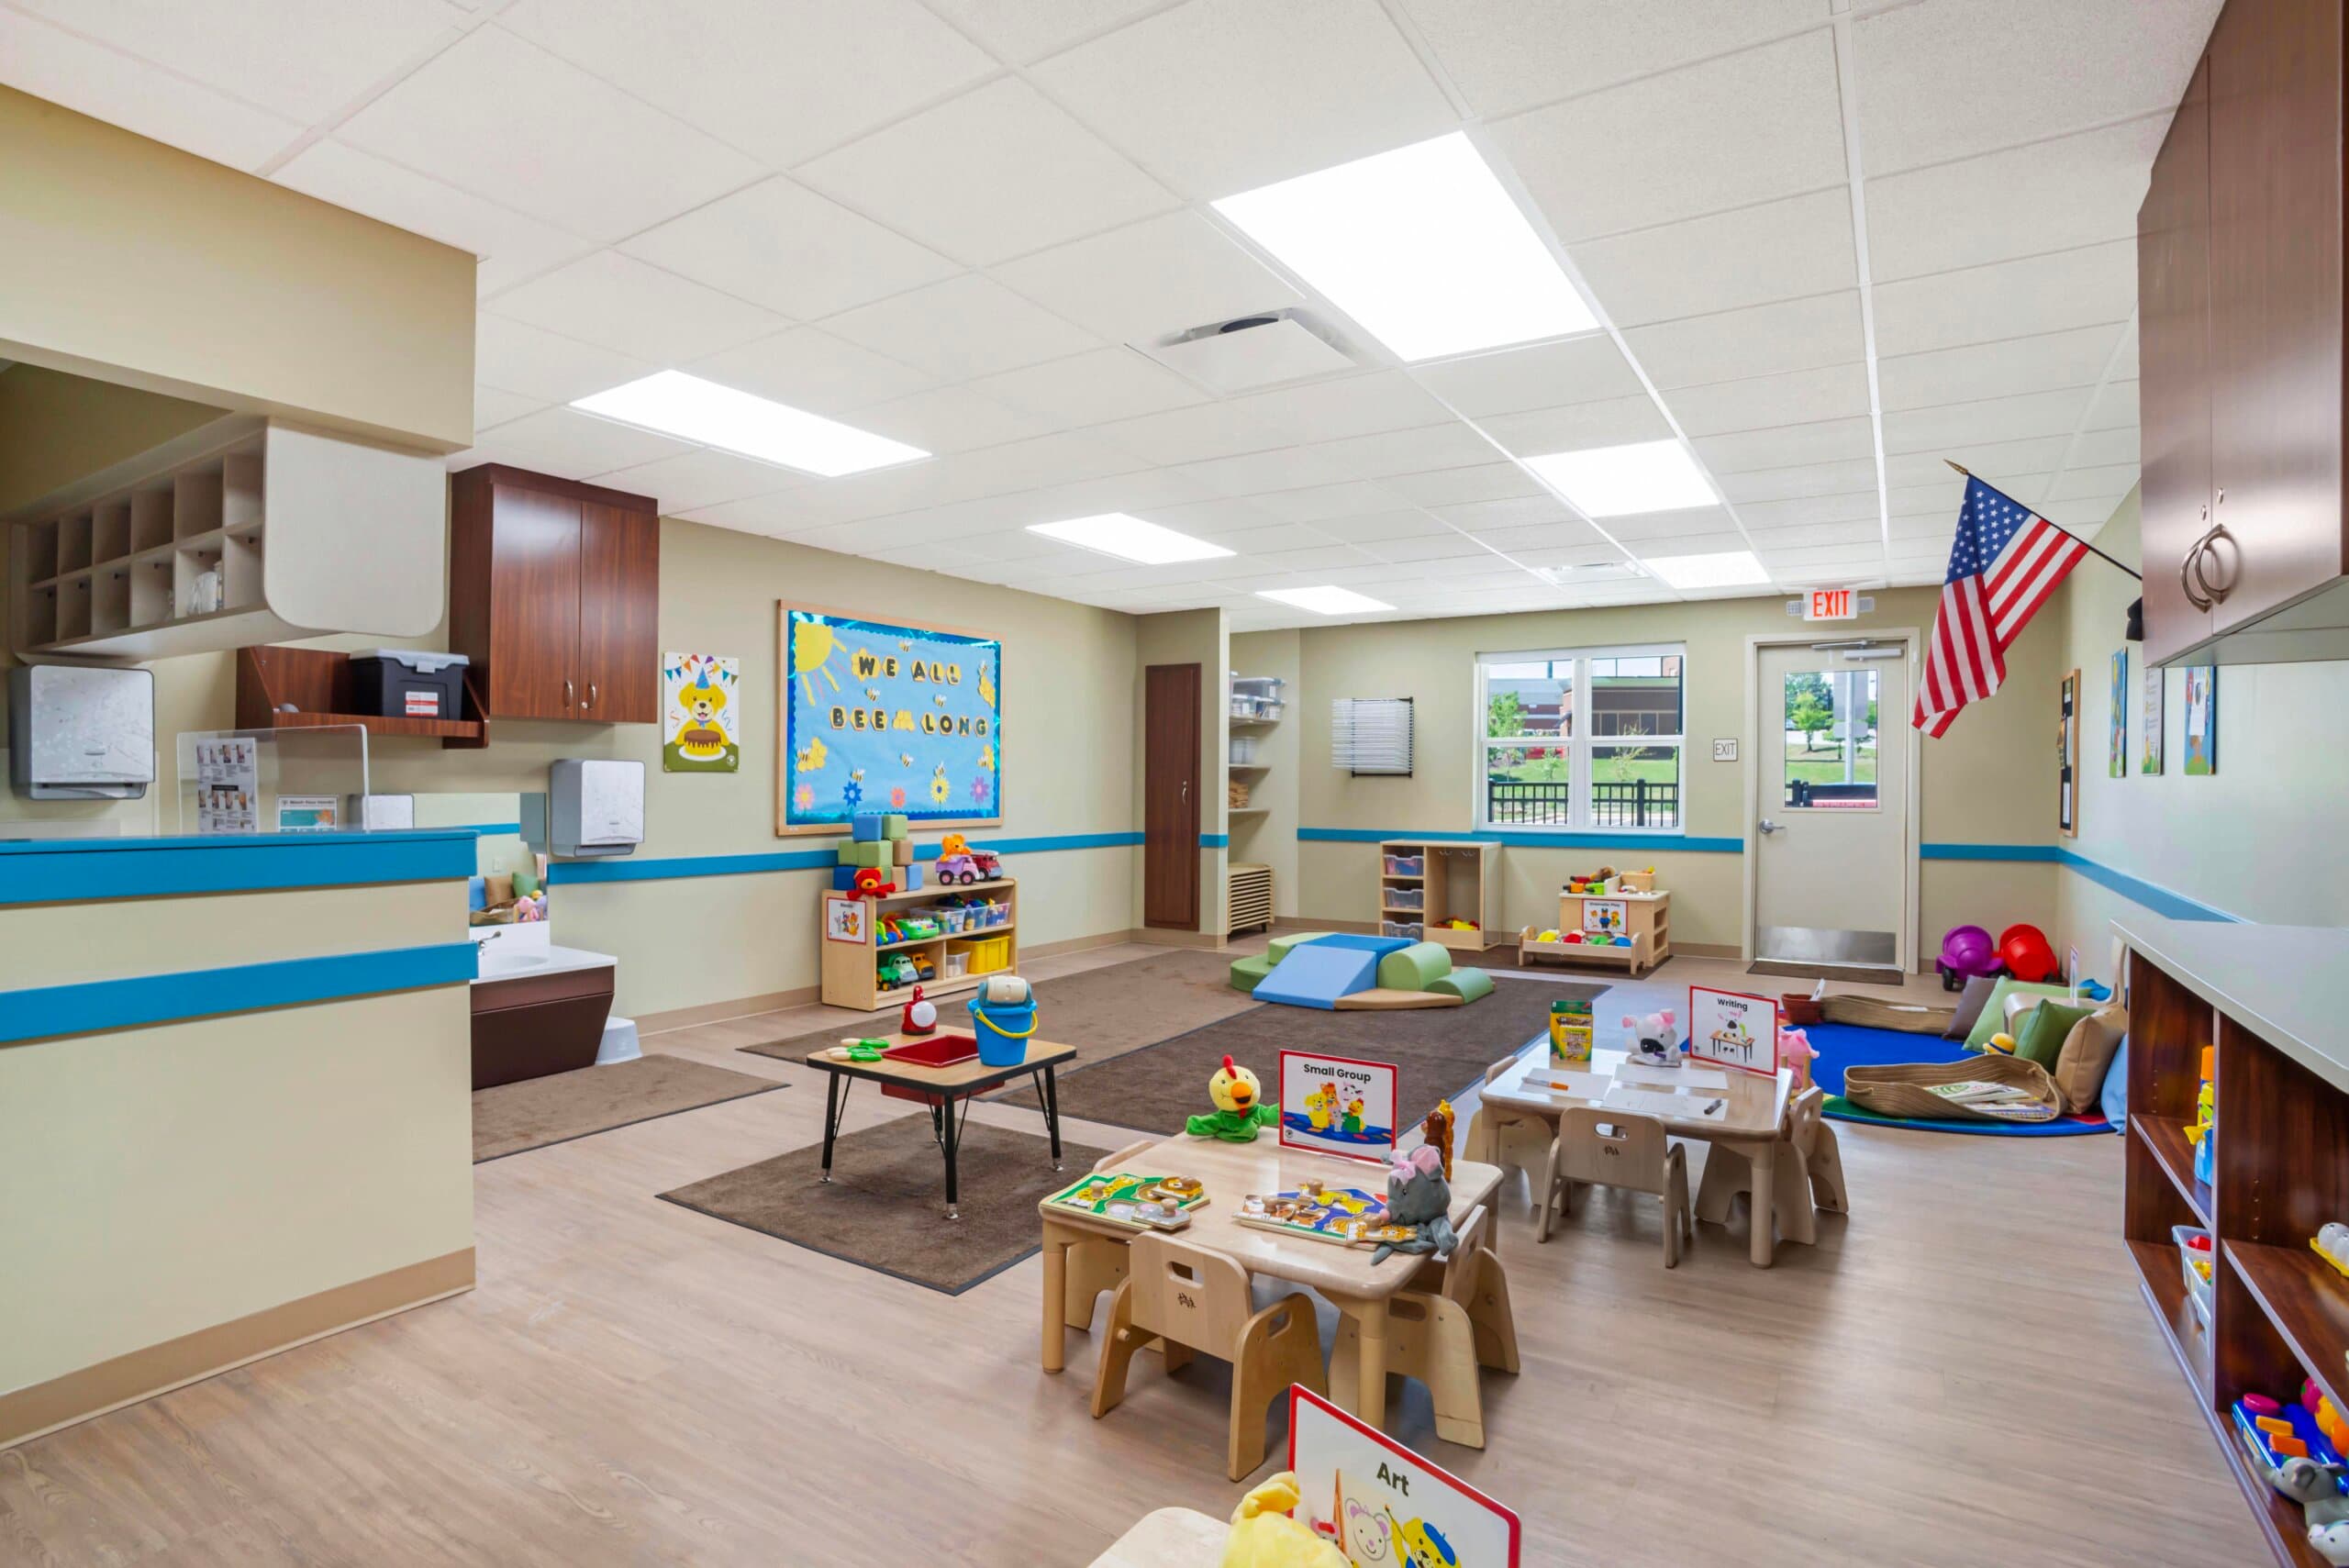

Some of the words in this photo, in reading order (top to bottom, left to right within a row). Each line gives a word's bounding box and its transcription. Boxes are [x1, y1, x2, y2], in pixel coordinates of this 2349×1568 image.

[1812, 590, 1851, 617] EXIT
[858, 656, 896, 677] WE
[912, 661, 959, 683] ALL
[832, 707, 885, 729] BEE
[925, 714, 986, 736] LONG
[1715, 742, 1736, 756] EXIT
[1717, 997, 1748, 1012] Writing
[1303, 1063, 1335, 1077] Small
[1336, 1068, 1372, 1084] Group
[1376, 1462, 1409, 1497] Art
